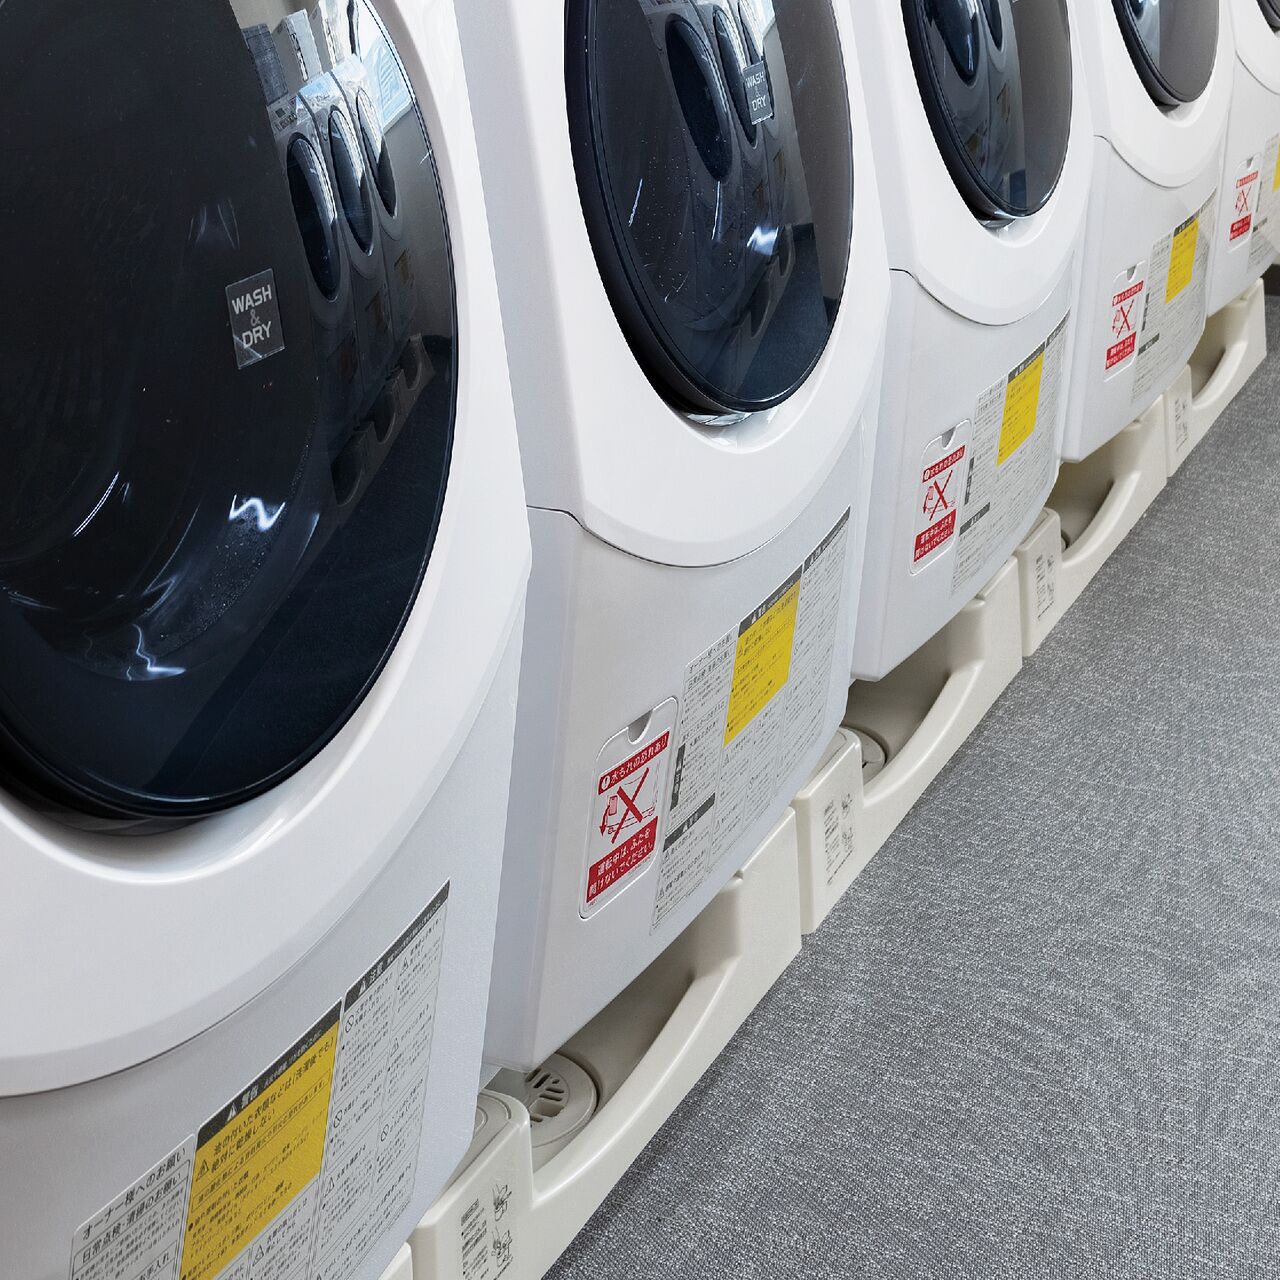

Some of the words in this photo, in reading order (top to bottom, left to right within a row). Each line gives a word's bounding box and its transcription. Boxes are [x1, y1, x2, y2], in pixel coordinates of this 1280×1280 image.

[745, 71, 765, 88] WASH
[751, 96, 768, 111] DRY
[232, 284, 272, 315] WASH
[250, 308, 261, 328] &
[242, 321, 272, 349] DRY
[610, 736, 667, 785] 水もれの恐れあり
[589, 842, 654, 898] 開けないでください。
[597, 827, 651, 876] 運転中は、ふたを
[213, 1036, 334, 1157] 油の付いた衣類などは(洗濯後でも)
[210, 1108, 276, 1174] 絶対に乾燥しない
[82, 1147, 186, 1241] オーナー様へのお願い
[82, 1172, 181, 1264] 日常点検・清掃のお願い
